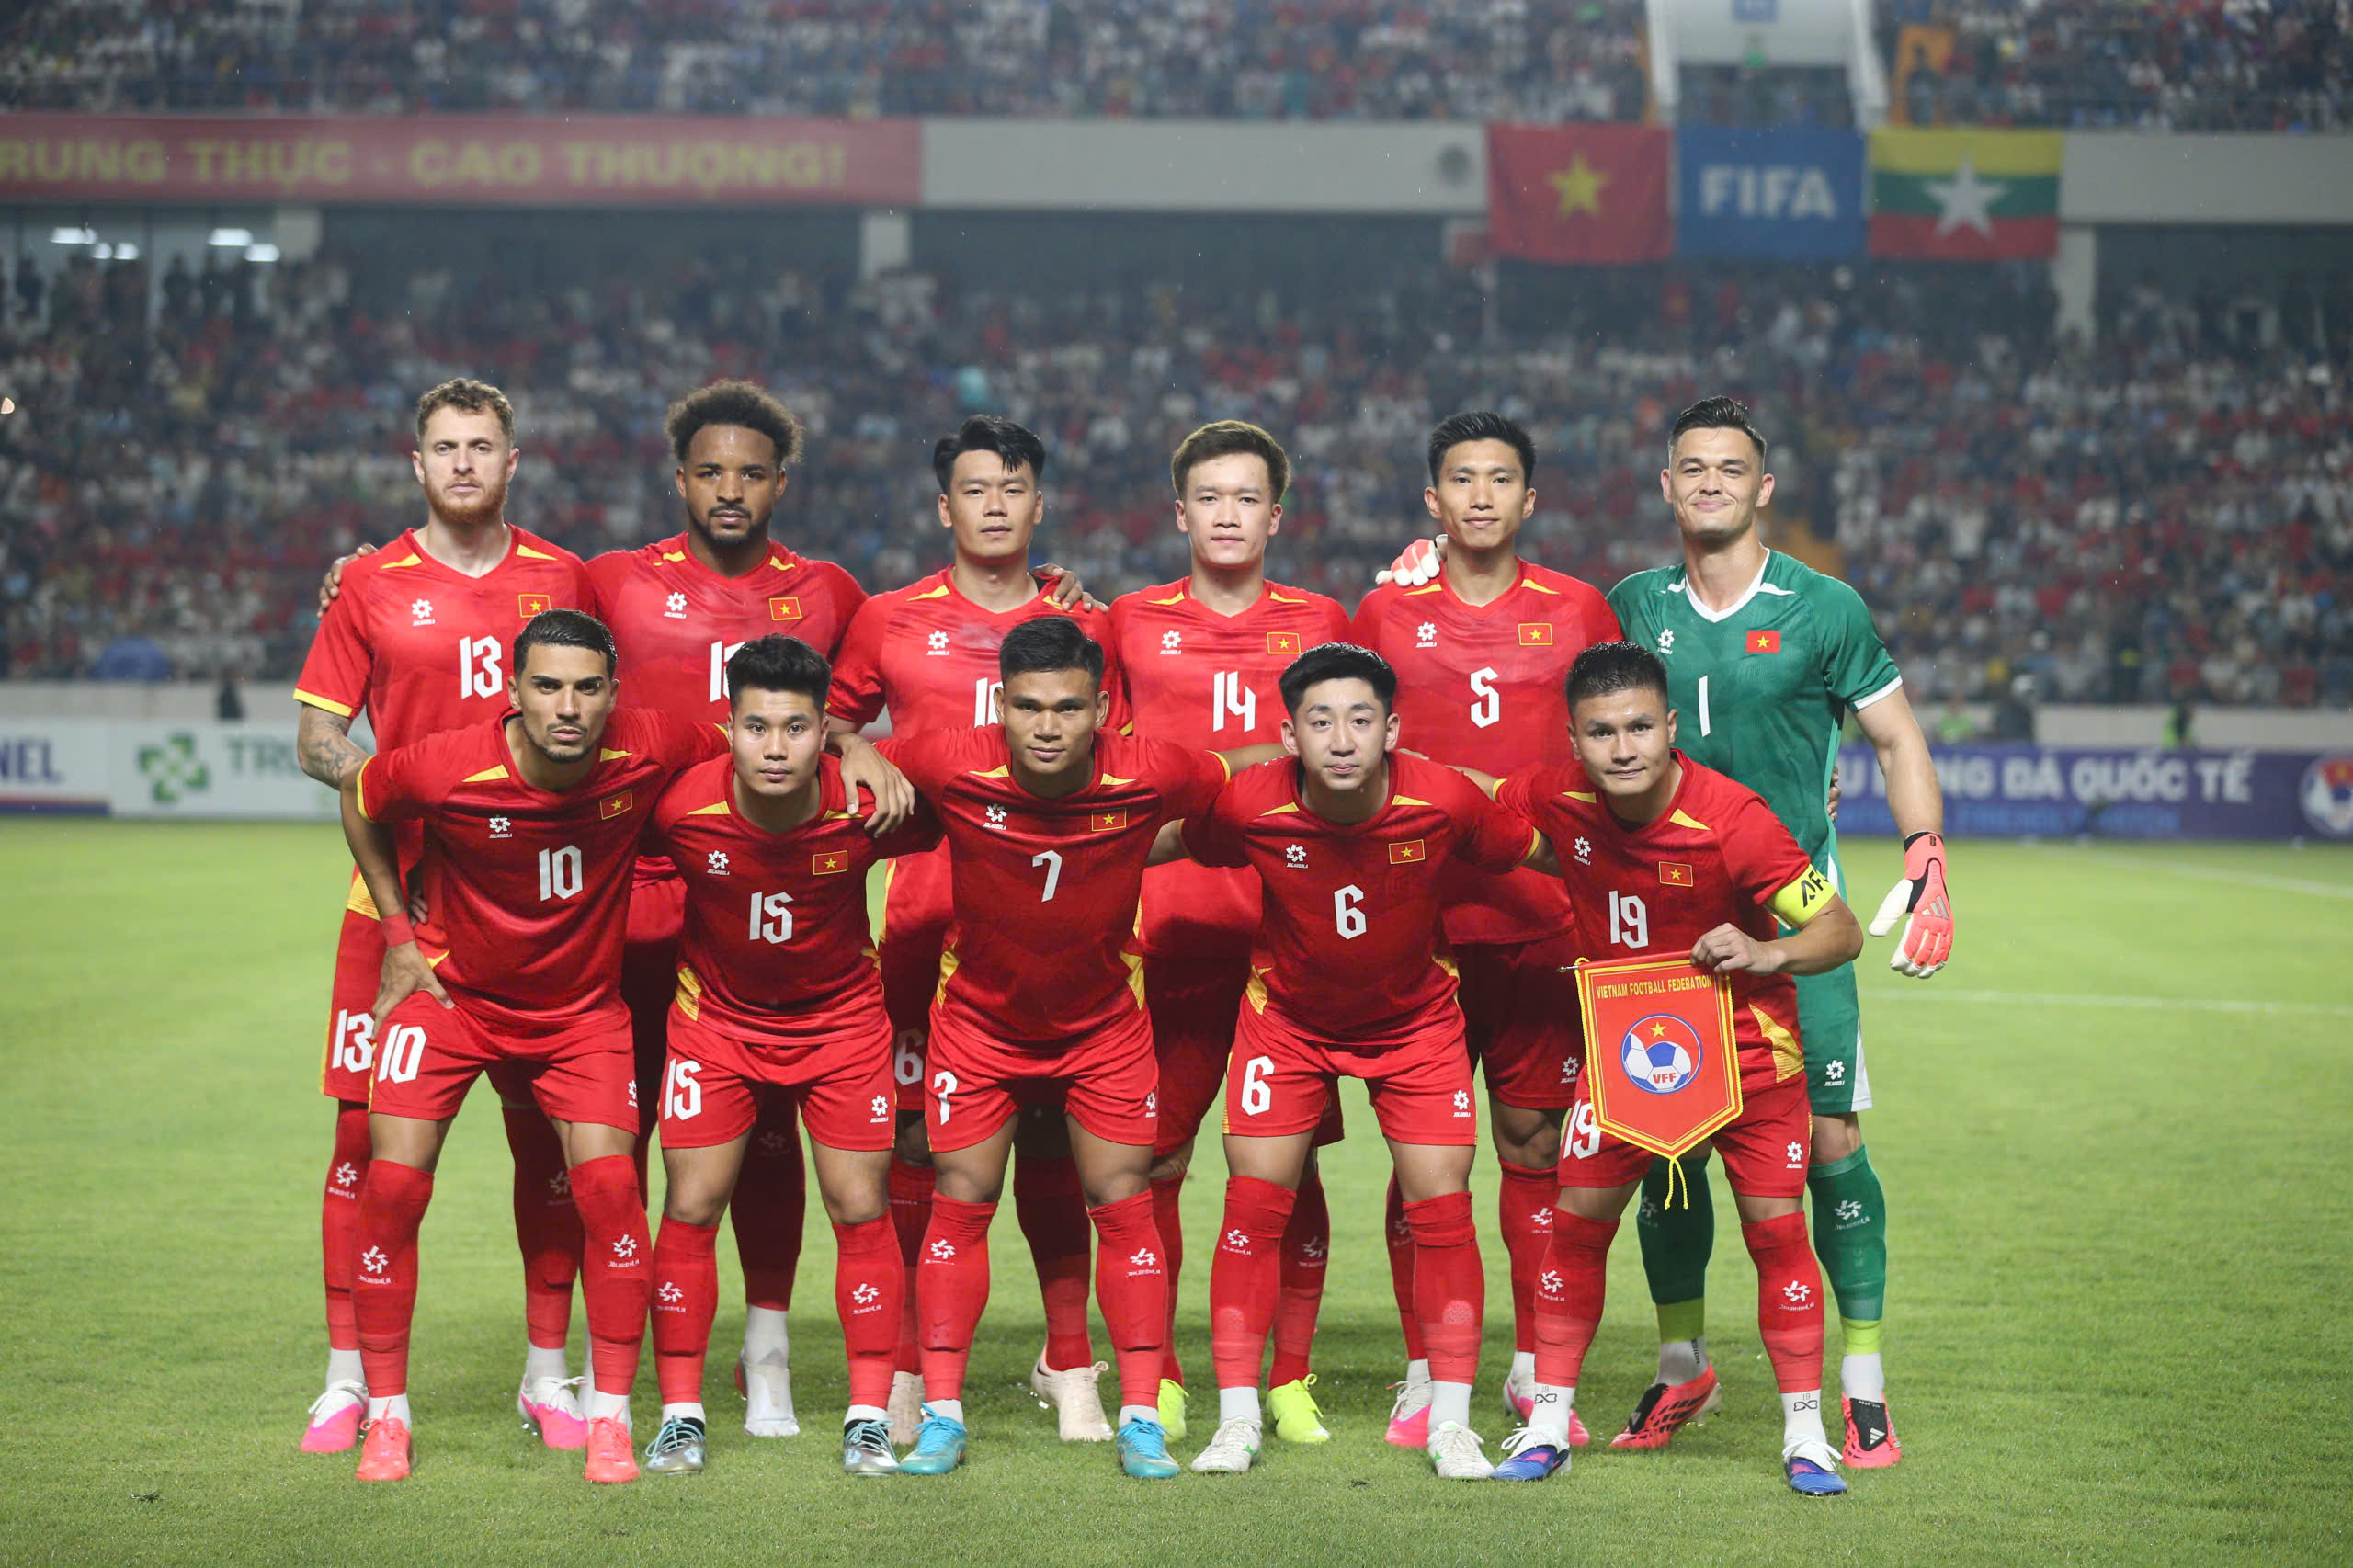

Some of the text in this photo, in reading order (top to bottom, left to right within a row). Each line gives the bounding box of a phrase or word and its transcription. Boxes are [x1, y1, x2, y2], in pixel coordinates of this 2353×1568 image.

[409, 140, 540, 187] CAO
[1699, 165, 1838, 219] FIFA
[460, 635, 503, 699] 13
[710, 641, 745, 703] 1
[1212, 670, 1256, 733] 14
[1470, 666, 1500, 729] 5
[1698, 675, 1711, 737] 1
[538, 845, 584, 902] 10
[1032, 849, 1063, 903] 7
[749, 892, 794, 945] 15
[1334, 884, 1368, 940] 6
[1608, 890, 1649, 949] 19
[1596, 973, 1712, 999] VIETNAM FOOTBALL FEDERATION
[332, 1009, 375, 1074] 13
[378, 1023, 427, 1084] 10
[664, 1059, 702, 1121] 15
[934, 1071, 958, 1125] 7
[1241, 1055, 1275, 1116] 6
[1652, 1073, 1677, 1084] VFF
[1563, 1098, 1601, 1160] 19
